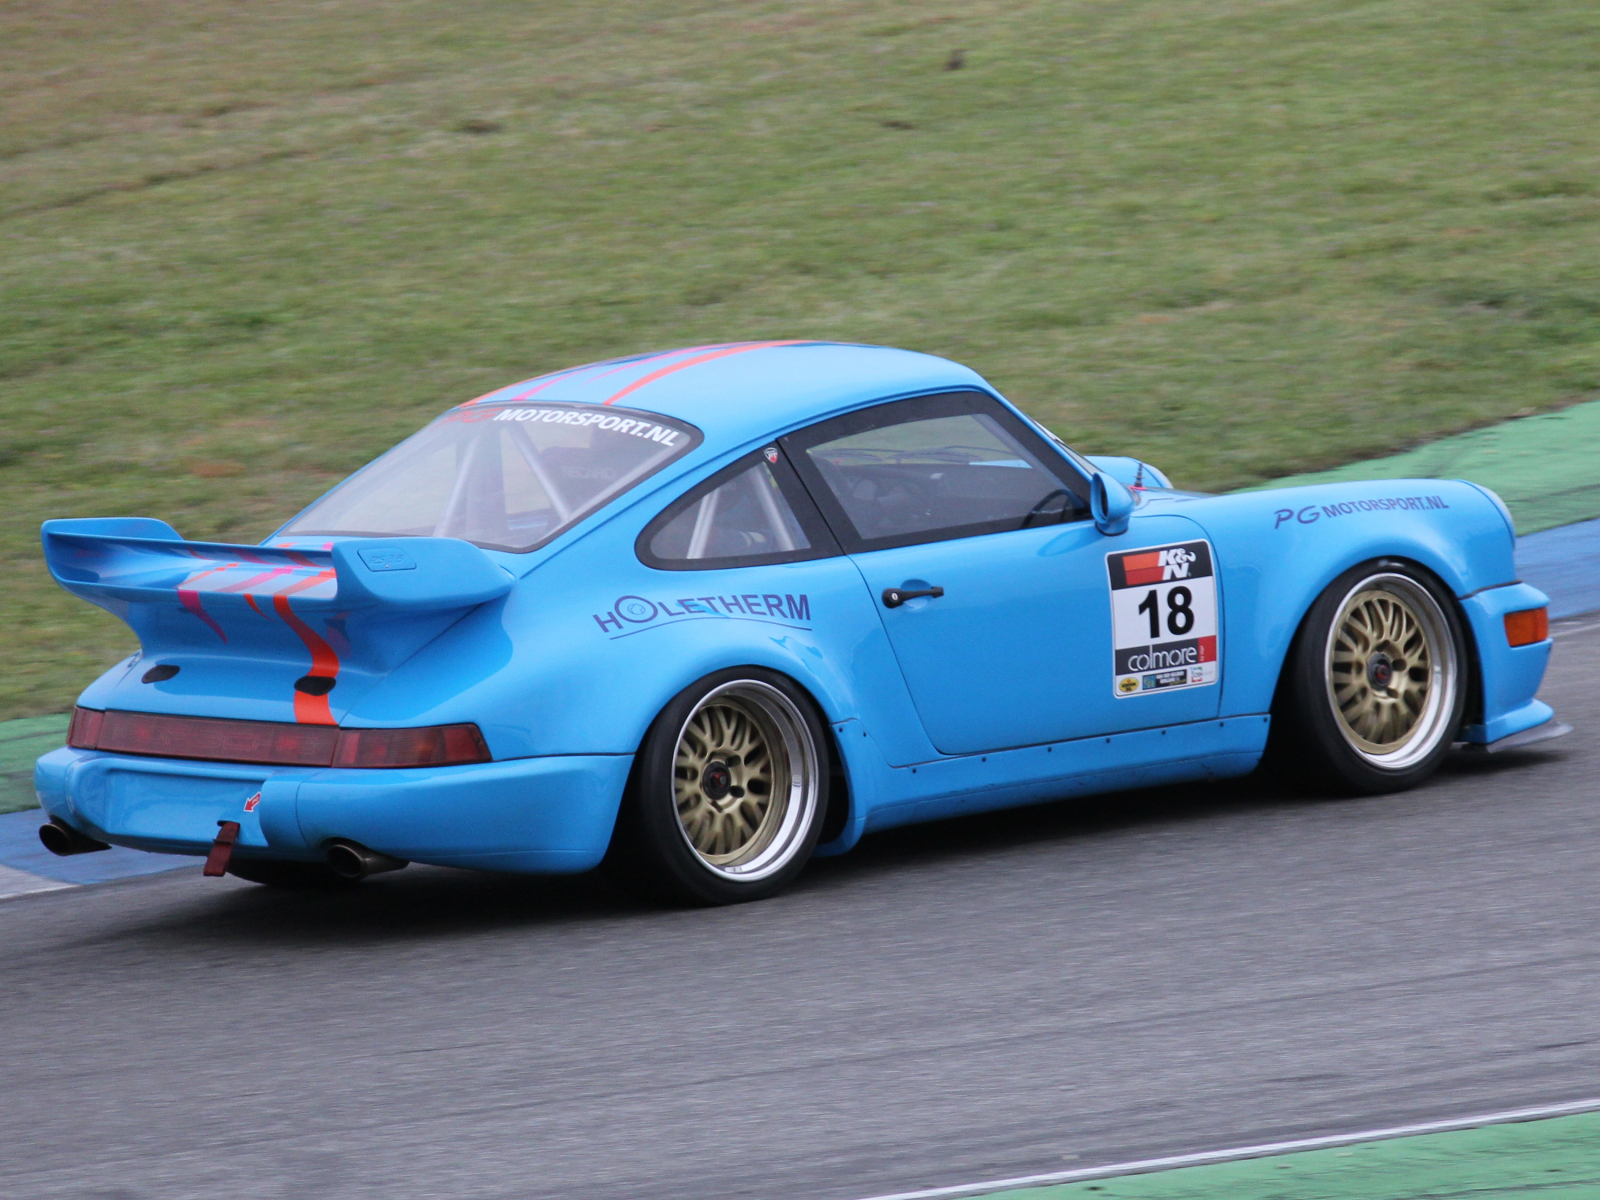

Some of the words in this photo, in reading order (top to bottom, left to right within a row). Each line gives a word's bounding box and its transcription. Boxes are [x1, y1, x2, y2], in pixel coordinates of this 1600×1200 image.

[430, 407, 505, 430] PG
[493, 408, 680, 447] MOTORSPORT.NL
[1274, 505, 1320, 529] PG
[1321, 496, 1449, 518] MOTORSPORT.NL
[592, 594, 811, 633] HOLETHERM
[1138, 585, 1195, 639] 18
[1128, 645, 1198, 671] colmore
